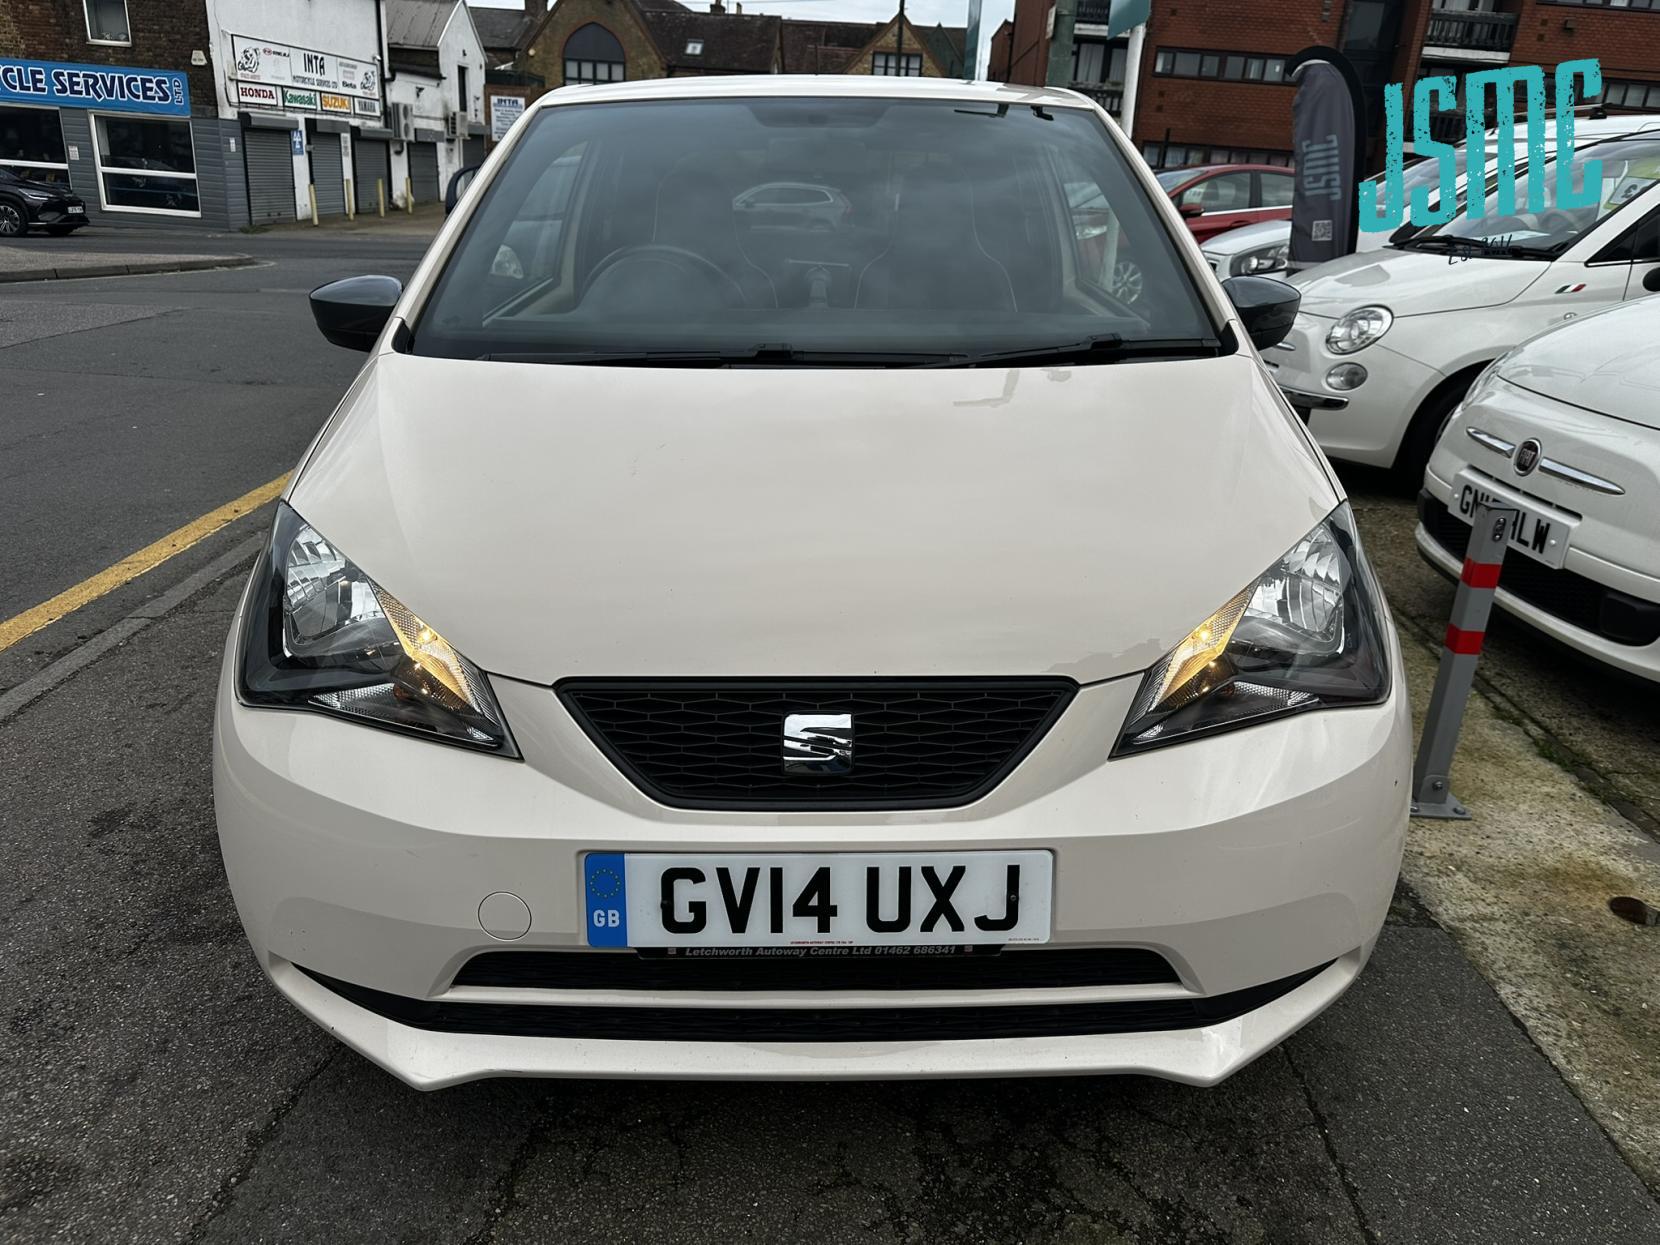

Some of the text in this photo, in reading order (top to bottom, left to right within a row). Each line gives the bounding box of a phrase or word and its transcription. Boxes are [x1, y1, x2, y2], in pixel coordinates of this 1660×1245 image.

[303, 52, 326, 77] INTA
[51, 69, 172, 103] SERVICES
[172, 78, 184, 105] LTD
[240, 87, 275, 100] HONDA
[283, 90, 317, 106] Kawasaki
[322, 94, 350, 109] SUZUKI
[660, 864, 1020, 935] GV14 UXJ
[593, 909, 620, 928] GB
[685, 947, 753, 956] Letchworth
[755, 947, 807, 957] Autoway
[810, 946, 850, 956] Centre
[852, 946, 872, 955] Ltd
[874, 945, 911, 955] 01462
